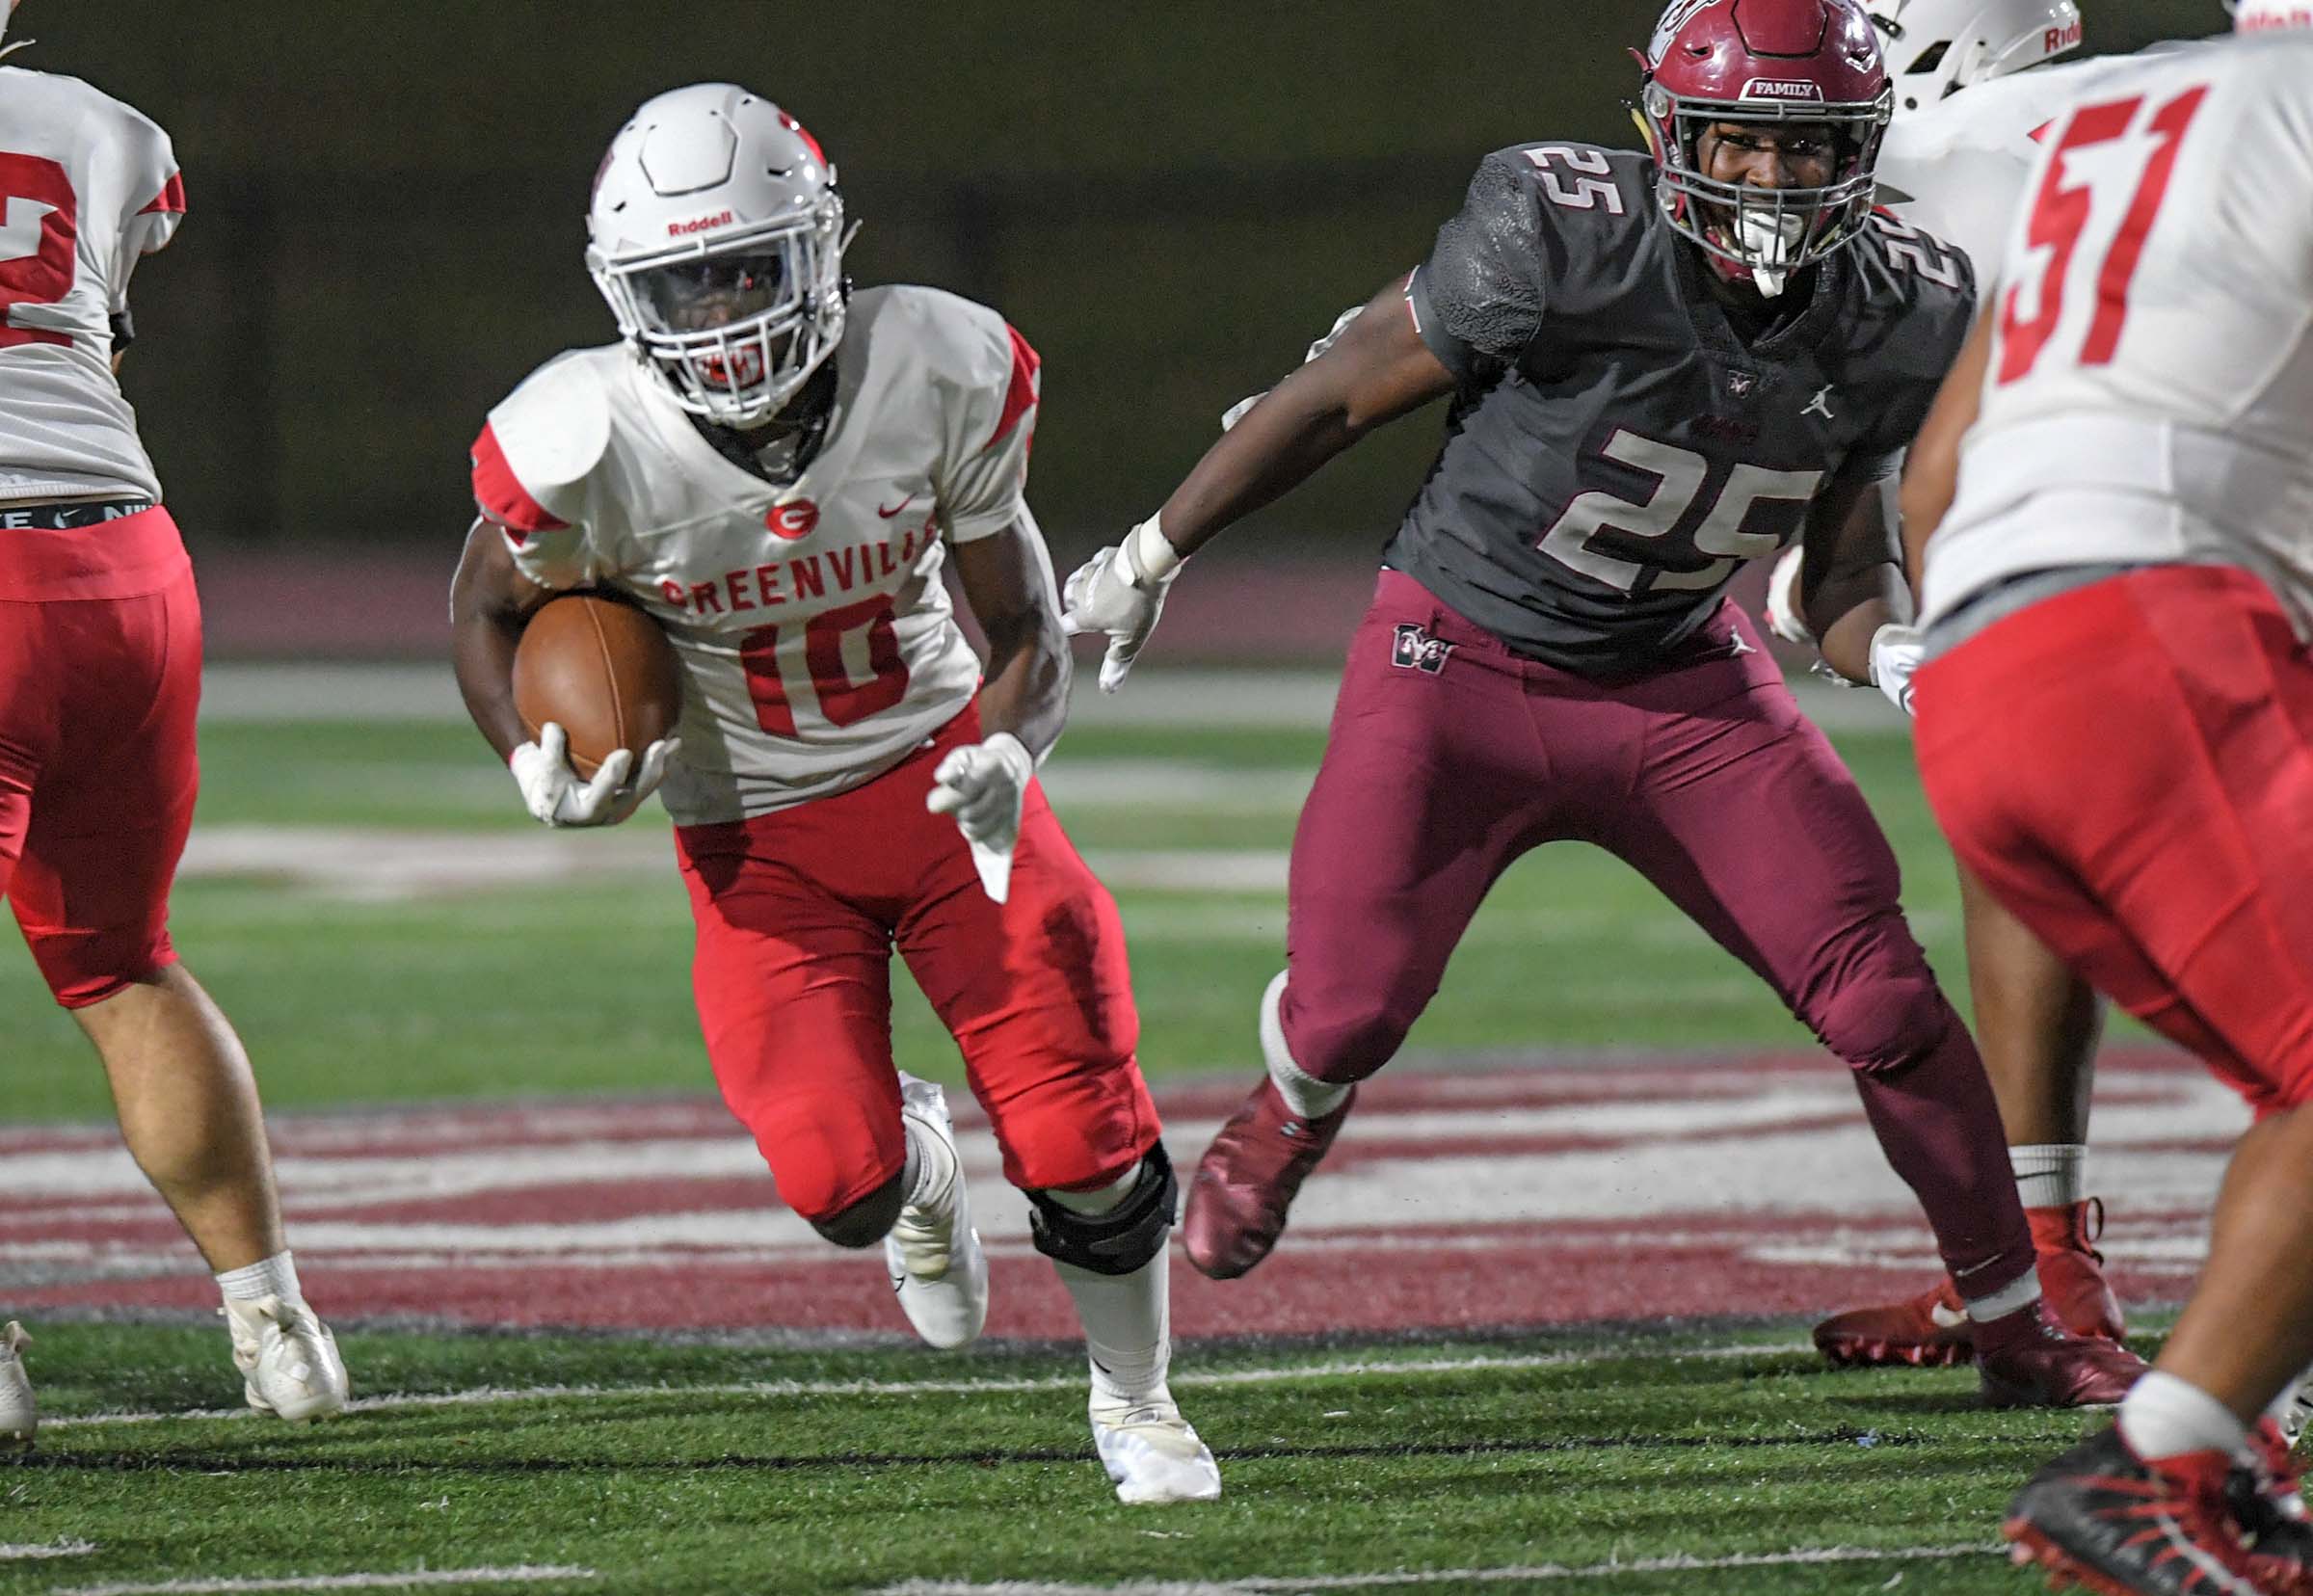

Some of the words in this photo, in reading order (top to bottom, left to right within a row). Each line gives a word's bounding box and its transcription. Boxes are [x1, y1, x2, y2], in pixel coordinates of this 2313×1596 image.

[1755, 81, 1813, 96] FAMILY
[669, 211, 731, 237] Riddell
[1521, 146, 1625, 215] 25
[1997, 83, 2210, 386] 51
[1537, 429, 1824, 590] 25
[740, 593, 910, 736] 10
